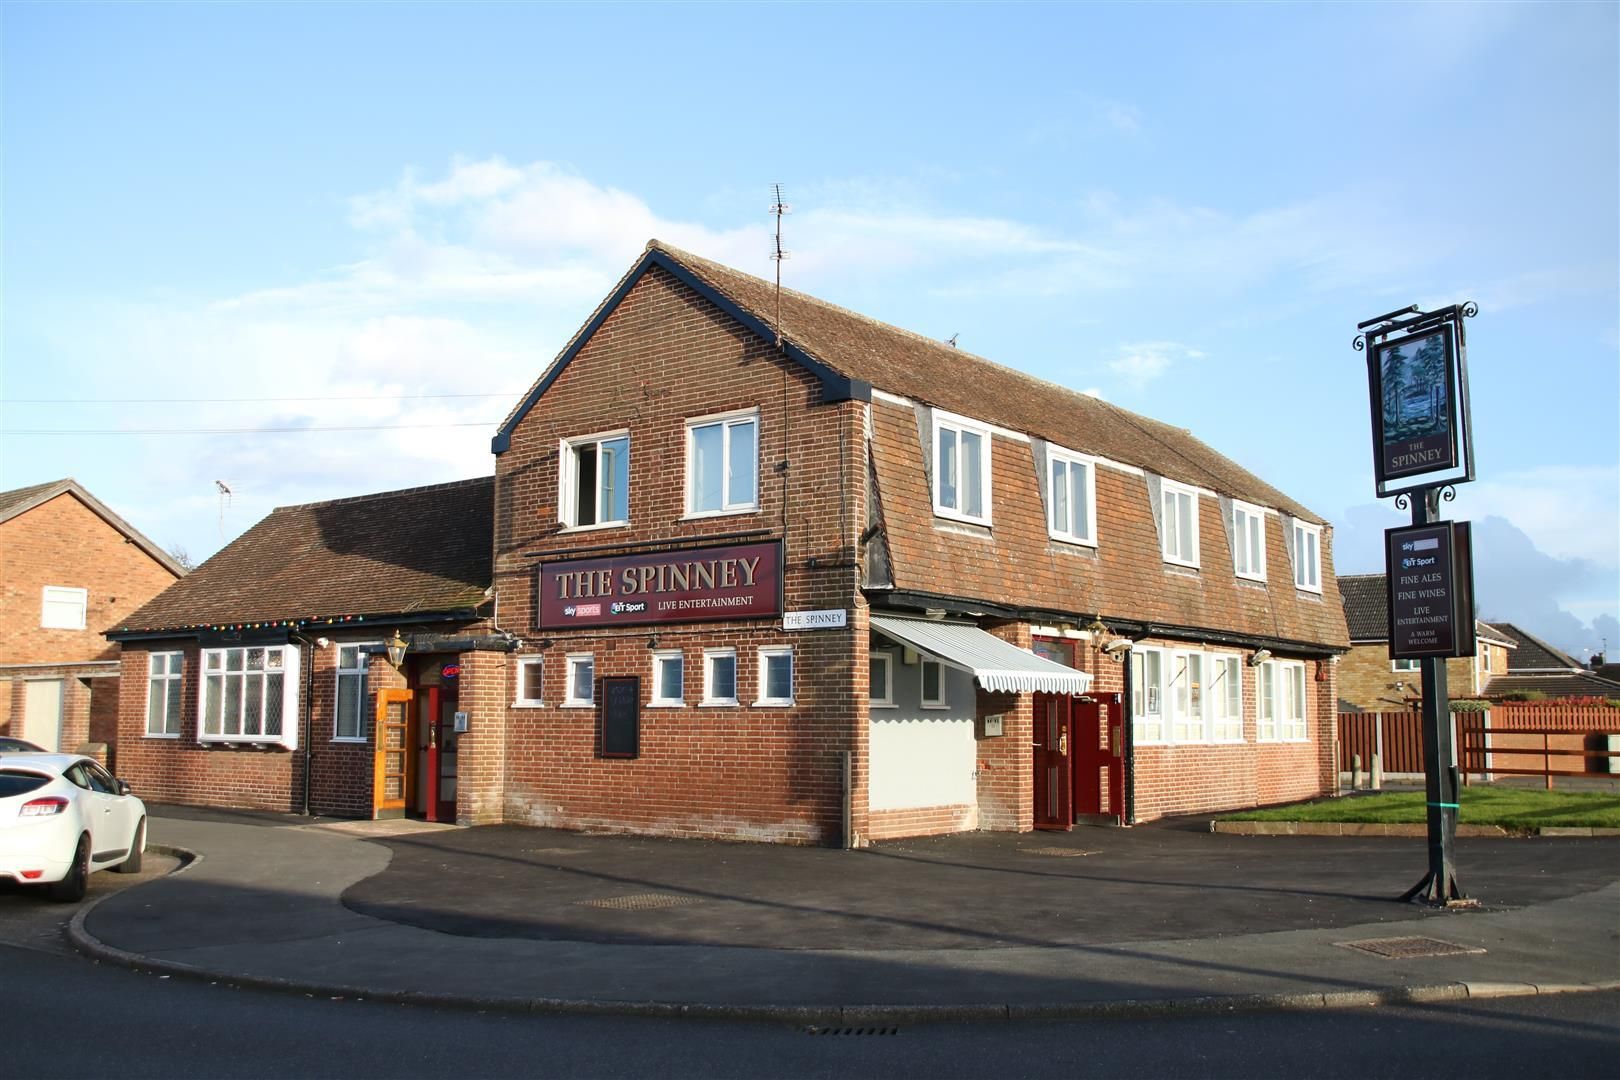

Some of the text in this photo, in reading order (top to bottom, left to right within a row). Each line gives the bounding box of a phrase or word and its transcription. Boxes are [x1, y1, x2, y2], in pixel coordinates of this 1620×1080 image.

[1409, 441, 1424, 451] THE
[1392, 448, 1442, 468] SPINNEY
[1402, 542, 1414, 551] sky
[1417, 557, 1435, 567] Sport
[556, 557, 760, 599] THE SPINNEY
[1400, 573, 1442, 585] FINE ALES
[1398, 588, 1446, 600] FINE WINES
[614, 602, 645, 613] BT Sport
[658, 596, 754, 611] LIVE ENTERTAINMENT
[564, 605, 600, 616] sky sports
[1413, 606, 1430, 615] LIVE
[786, 613, 842, 625] THE SPINNEY
[1397, 615, 1448, 625] ENTERTAINMENT
